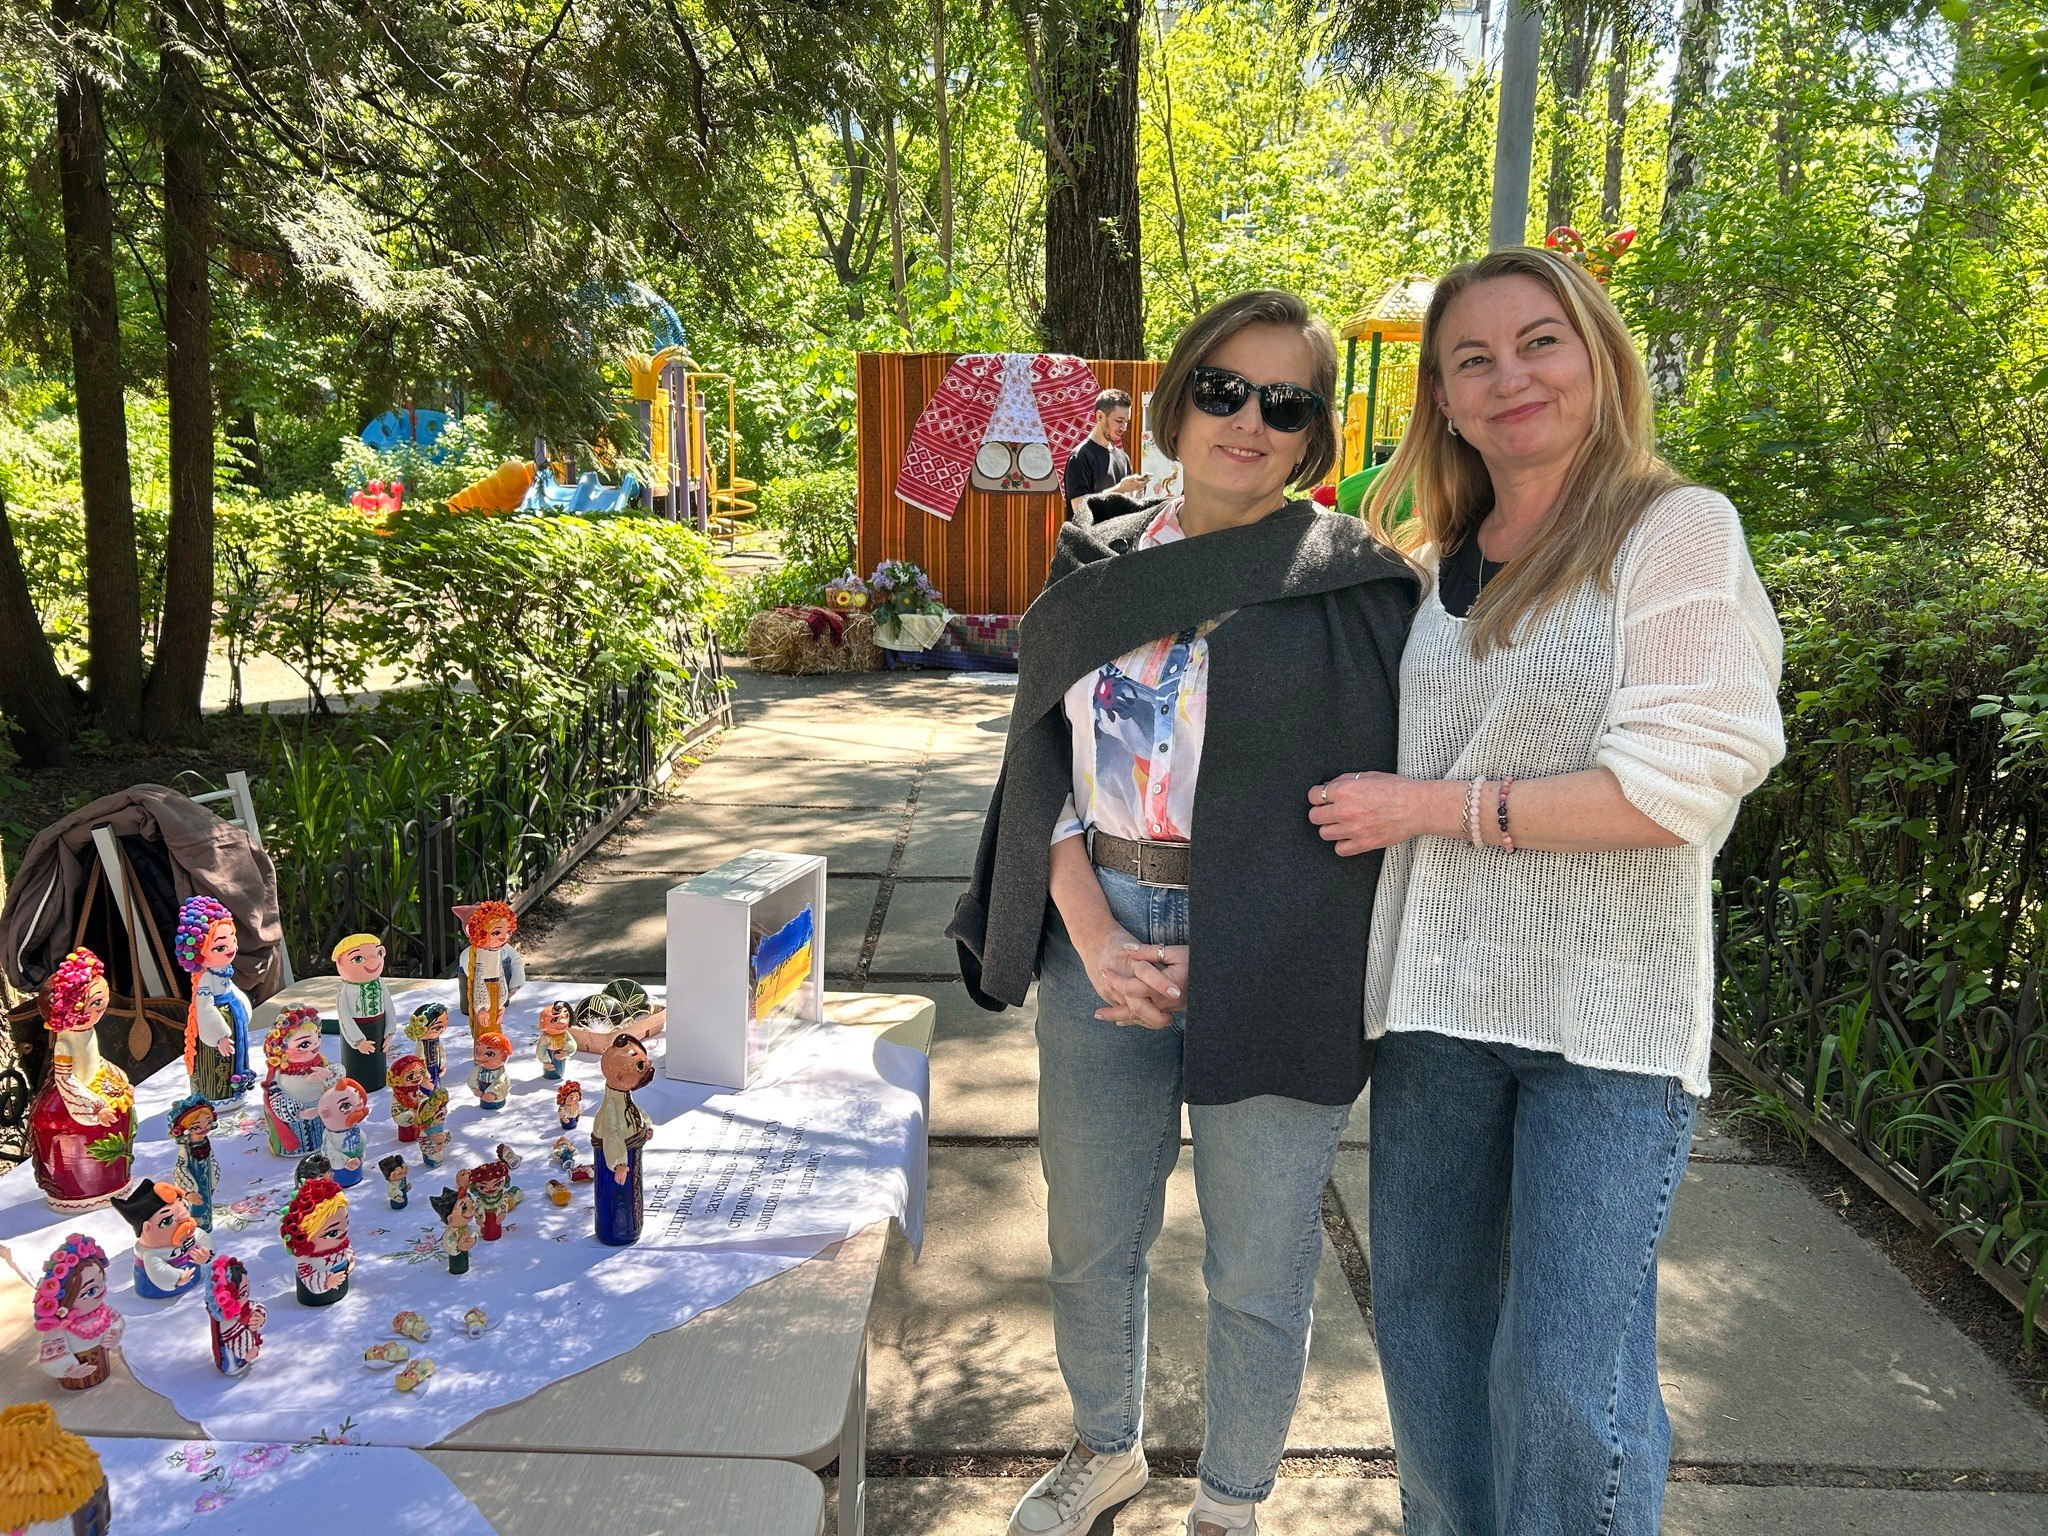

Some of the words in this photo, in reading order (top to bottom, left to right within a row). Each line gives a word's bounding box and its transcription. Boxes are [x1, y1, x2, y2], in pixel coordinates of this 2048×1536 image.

[759, 1137, 775, 1154] для
[762, 1119, 782, 1137] ЗСУ
[772, 1116, 812, 1176] Херсонському
[643, 1166, 683, 1218] Придбайте
[705, 1162, 738, 1214] захисників
[732, 1128, 754, 1156] кошти
[728, 1155, 768, 1229] спрямовуються
[772, 1178, 786, 1190] на
[662, 1174, 705, 1237] підтримайте
[755, 1191, 781, 1232] хлопцям
